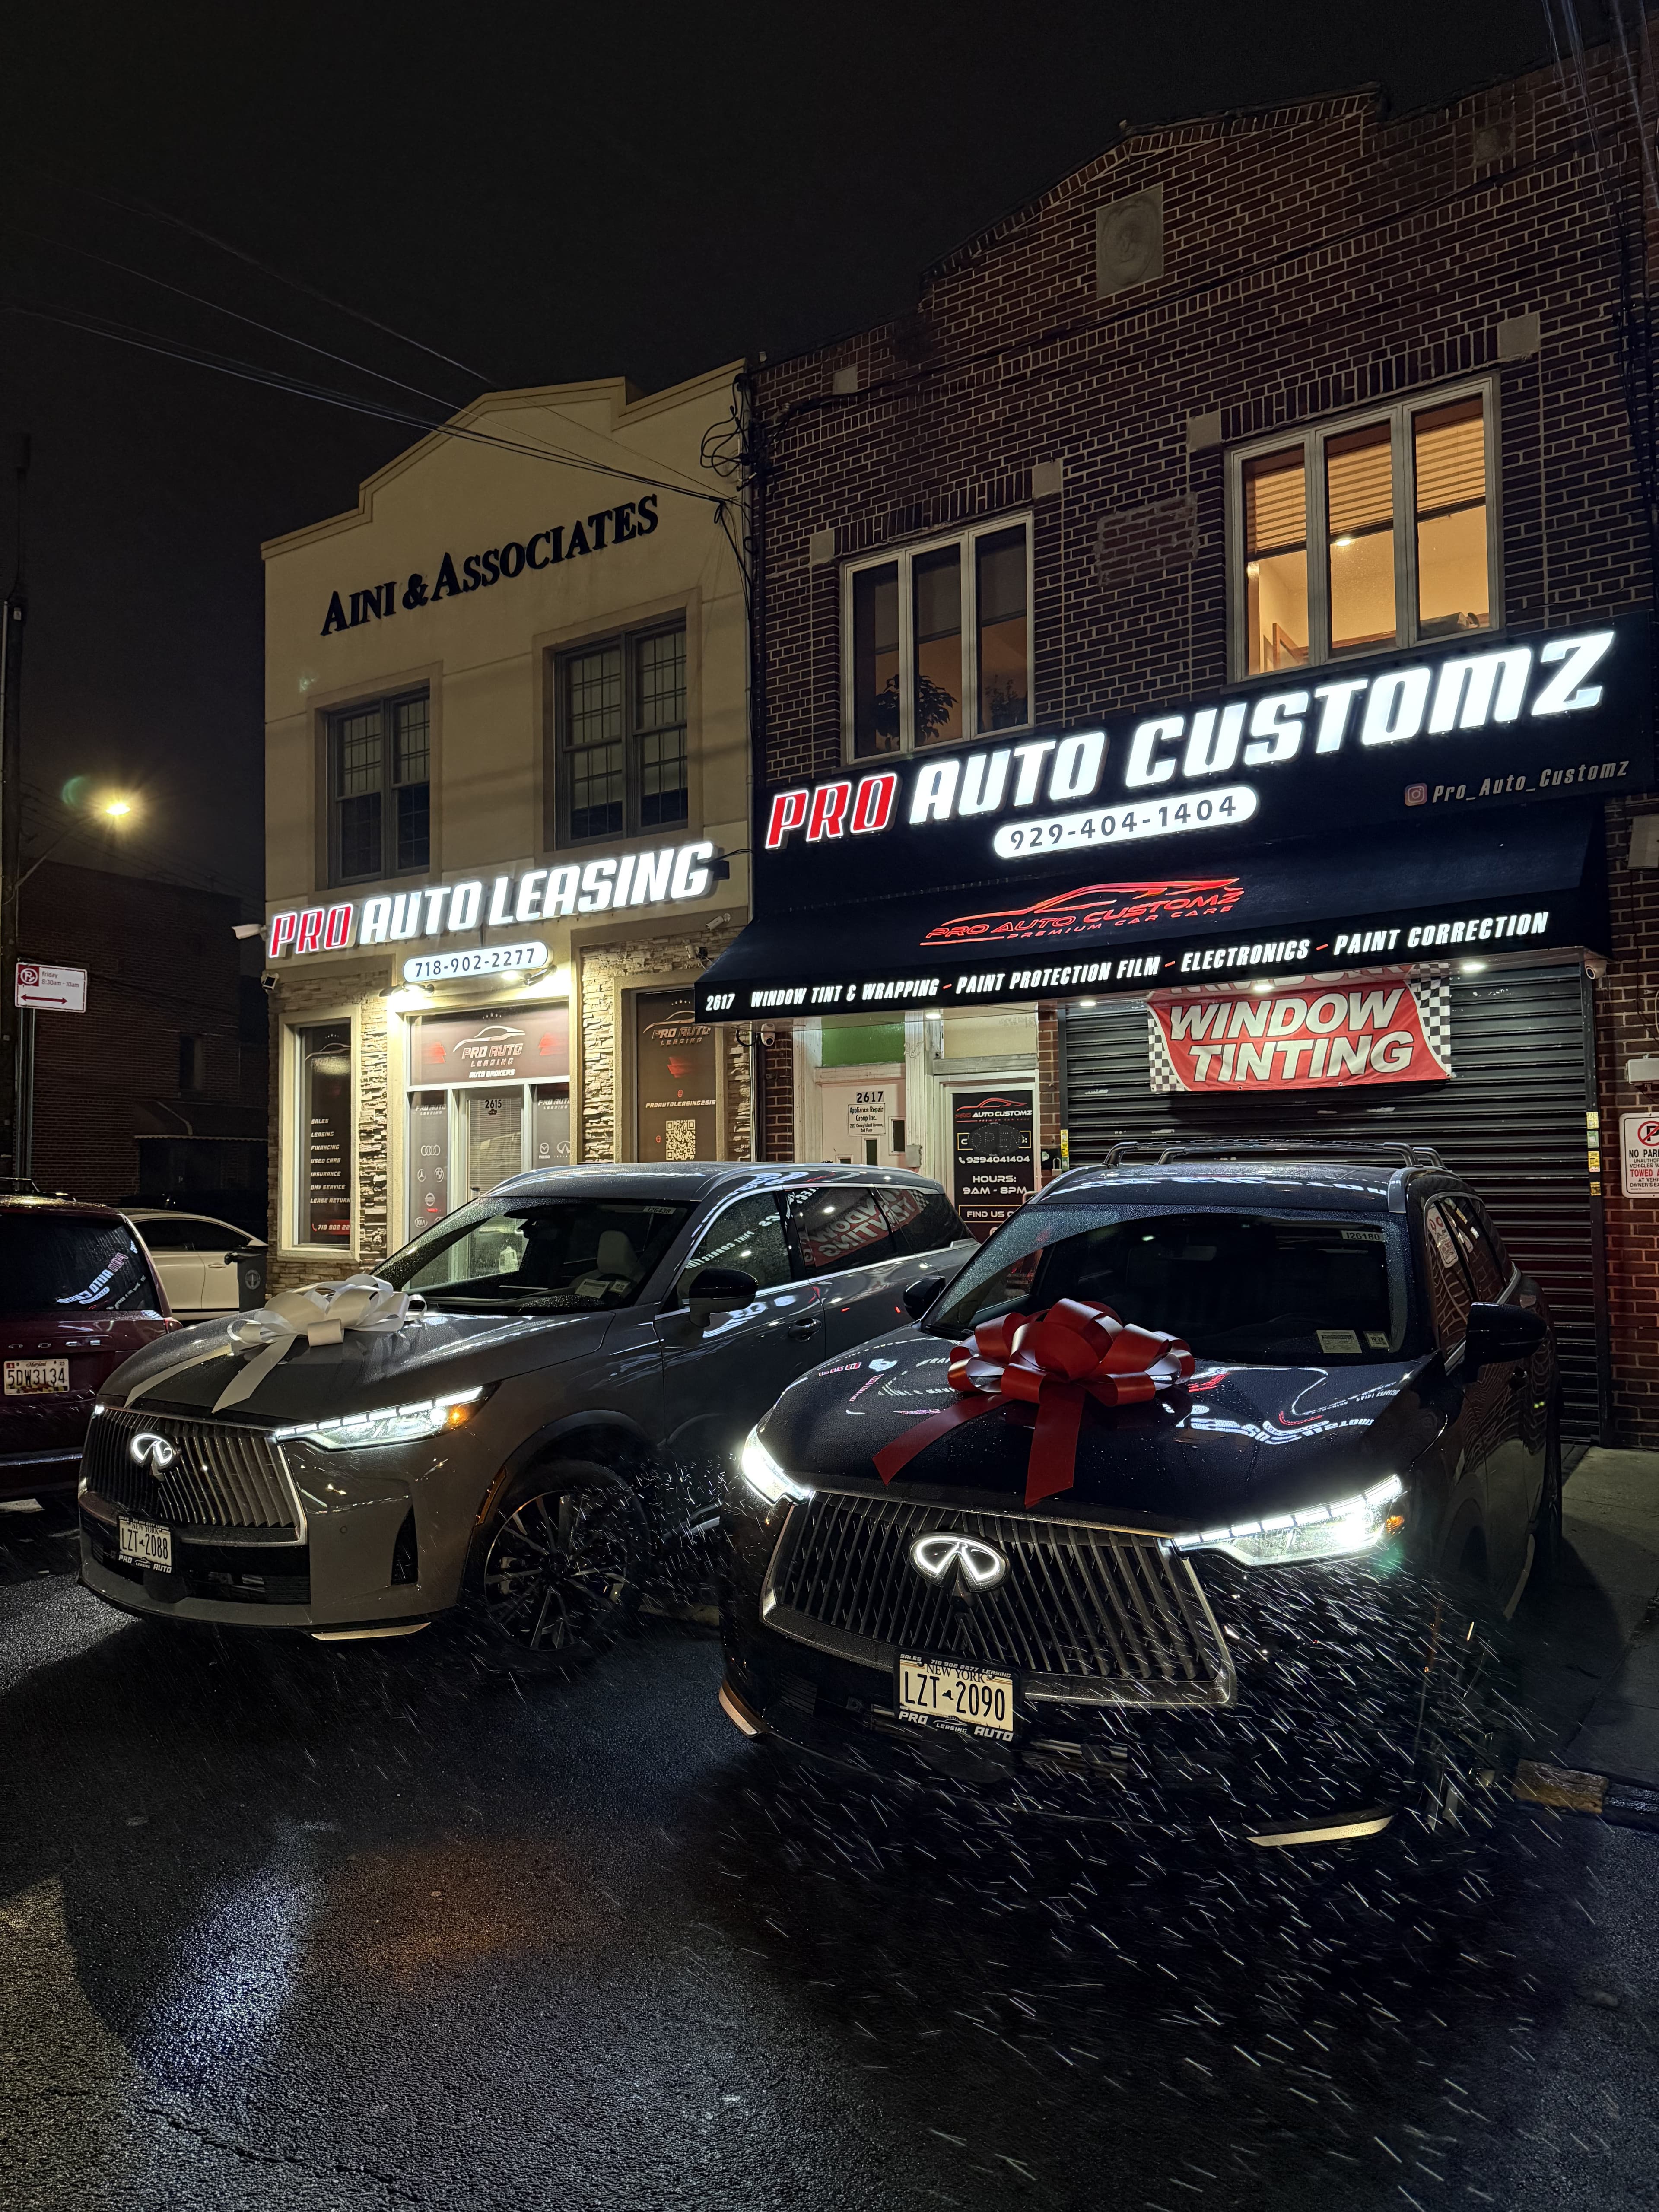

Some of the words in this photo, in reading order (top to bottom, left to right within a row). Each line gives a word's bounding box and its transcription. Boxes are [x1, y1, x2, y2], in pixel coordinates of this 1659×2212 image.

[320, 581, 397, 636] AINI
[402, 573, 429, 610] &
[429, 493, 659, 602] ASSOCIATES
[764, 772, 898, 850] PRO
[908, 731, 1107, 826] AUTO
[1125, 631, 1615, 788] CUSTOMZ
[1433, 760, 1630, 804] Pro_Auto_Customz
[1010, 795, 1236, 851] 929-404-1404
[269, 903, 354, 958] PRO
[359, 881, 484, 945] AUTO
[488, 841, 714, 927] LEASING
[925, 924, 990, 939] PRO
[990, 915, 1077, 933] AUTO
[1083, 887, 1245, 924] CUSTOMZ
[1006, 923, 1102, 939] PREMIUM
[1114, 914, 1158, 927] CAR
[1170, 905, 1233, 918] CARE
[415, 948, 535, 978] 718-902-2277
[705, 993, 735, 1011] 2617
[750, 987, 806, 1008] WINDOW
[810, 984, 842, 1003] TINT
[846, 985, 856, 1001] &
[861, 978, 940, 1000] WRAPPING
[955, 973, 1003, 995] PAINT
[1008, 960, 1112, 989] PROTECTION
[1116, 956, 1161, 979] FILM
[1180, 938, 1310, 973] ELECTRONICS
[1333, 928, 1401, 956] PAINT
[1406, 910, 1549, 948] CORRECTION
[1170, 988, 1407, 1041] WINDOW
[652, 1027, 678, 1040] PRO
[678, 1025, 712, 1037] AUTO
[660, 1037, 702, 1046] LEASING
[461, 1046, 489, 1059] PRO
[489, 1042, 524, 1058] AUTO
[1189, 1030, 1414, 1083] TINTING
[470, 1058, 514, 1068] LEASING
[469, 1070, 486, 1079] AUTO
[485, 1068, 516, 1078] BROKERS
[484, 1099, 502, 1109] 2615
[645, 1100, 716, 1109] PROAUTOLEASING2615
[857, 1091, 884, 1103] 2617
[966, 1155, 1030, 1163] 9294041404
[1629, 1149, 1639, 1158] NO
[1630, 1169, 1653, 1177] TOWED
[962, 1186, 991, 1195] 9AM
[8, 1367, 65, 1386] 5DW3134
[131, 1522, 144, 1531] NEW
[145, 1525, 159, 1535] YORK
[145, 1534, 168, 1560] 2088
[118, 1554, 133, 1564] PRO
[153, 1563, 172, 1573] AUTO
[900, 1653, 922, 1662] SALES
[982, 1669, 1011, 1678] LEASING
[925, 1663, 951, 1678] NEW
[954, 1669, 986, 1684] YORK
[955, 1681, 1006, 1722] 2090
[898, 1710, 929, 1725] PRO
[973, 1726, 1014, 1742] AUTO
[936, 1723, 968, 1734] LEASING
